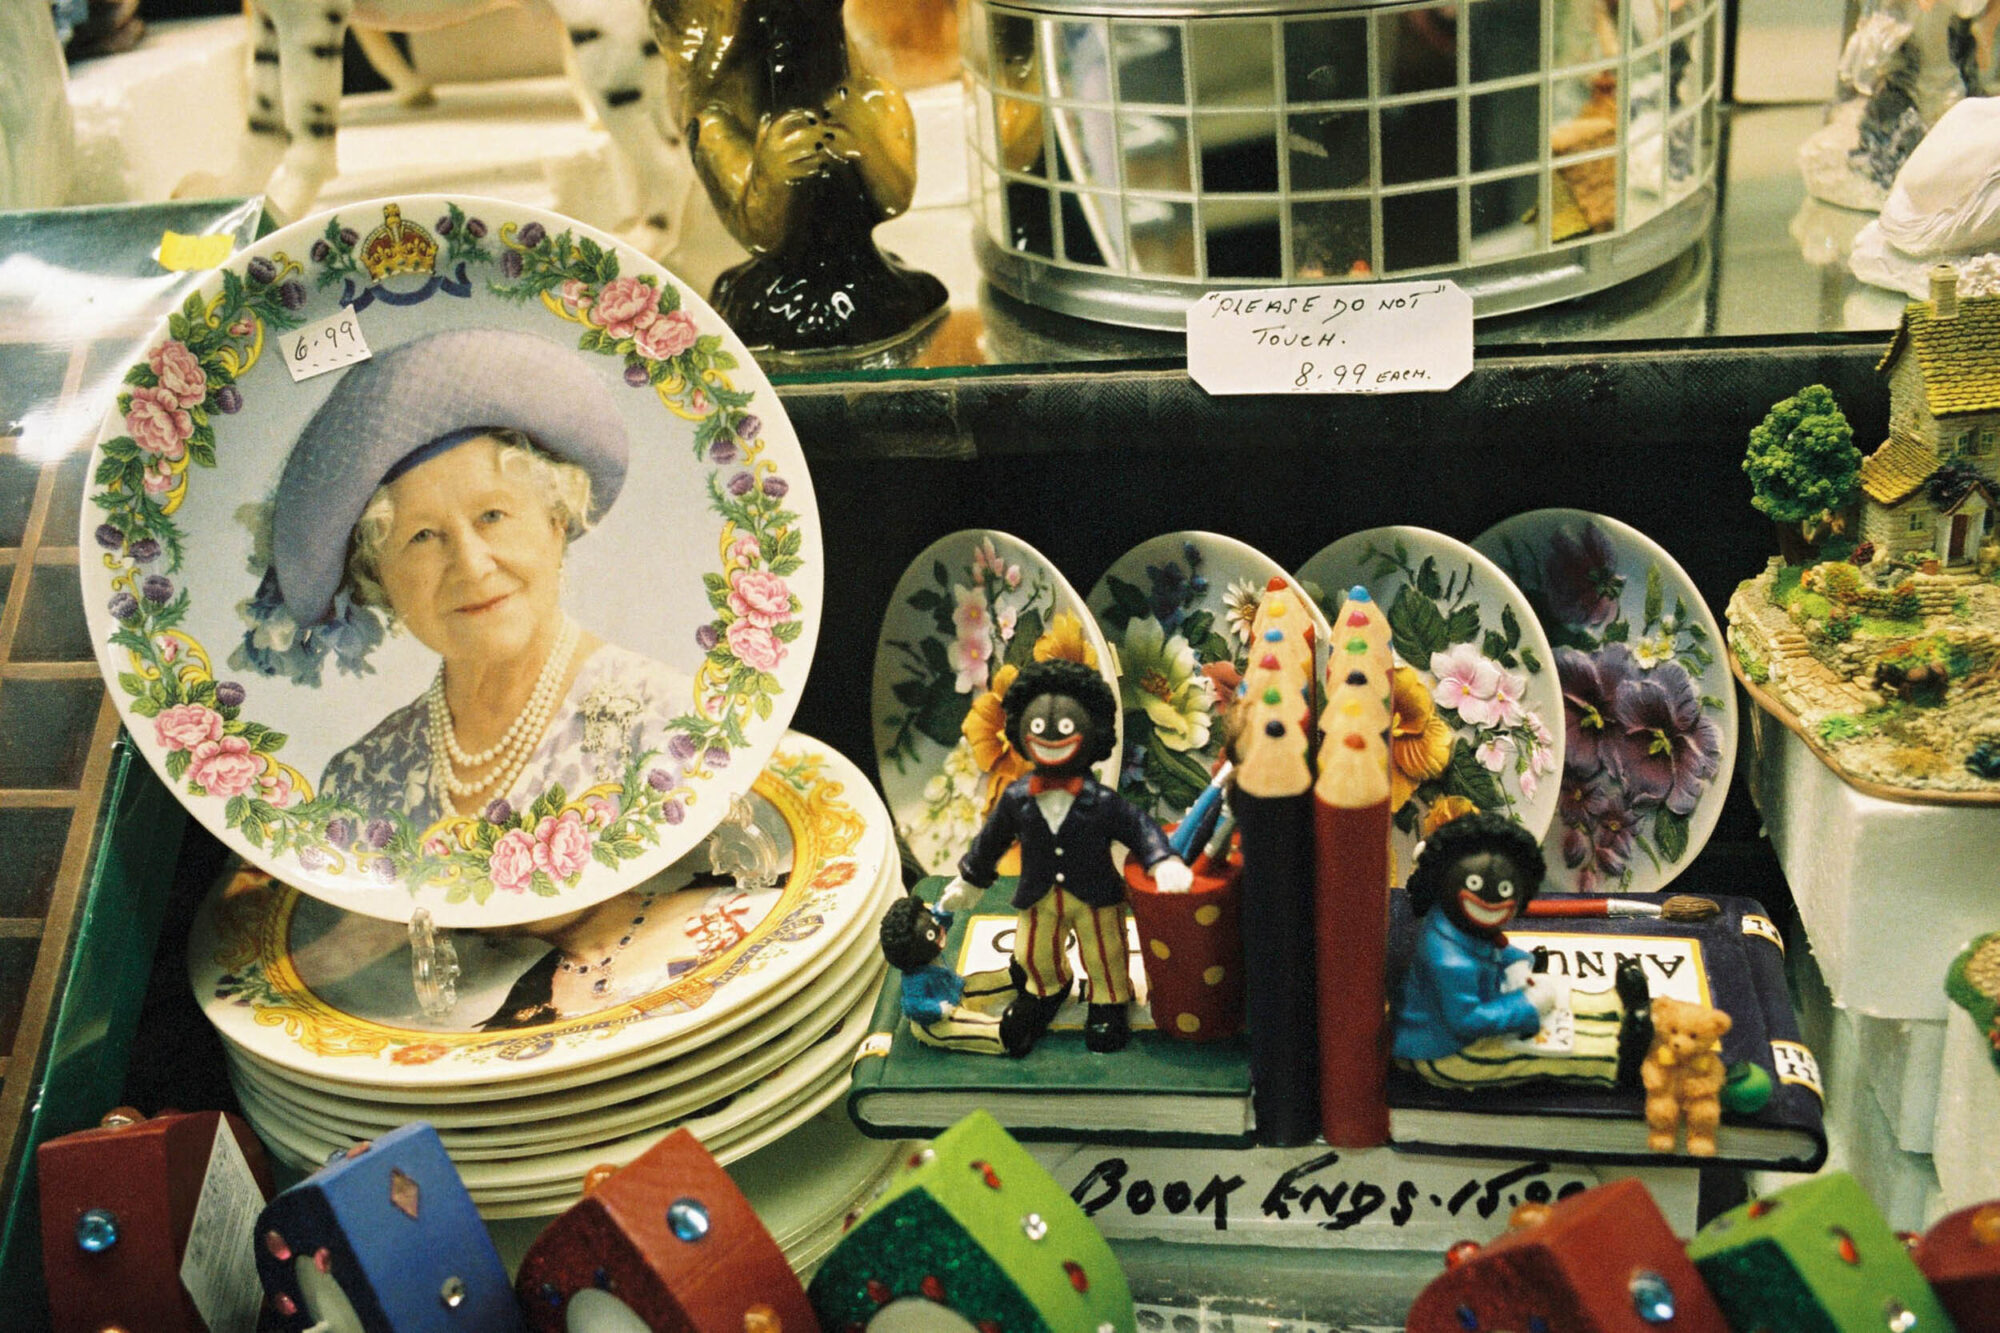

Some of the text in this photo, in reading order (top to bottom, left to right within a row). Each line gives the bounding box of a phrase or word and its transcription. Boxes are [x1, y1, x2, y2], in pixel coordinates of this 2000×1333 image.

[1322, 298, 1365, 324] DO
[294, 321, 356, 361] 6.99
[1294, 361, 1368, 386] 8.99
[1070, 1158, 1246, 1230] BOOK
